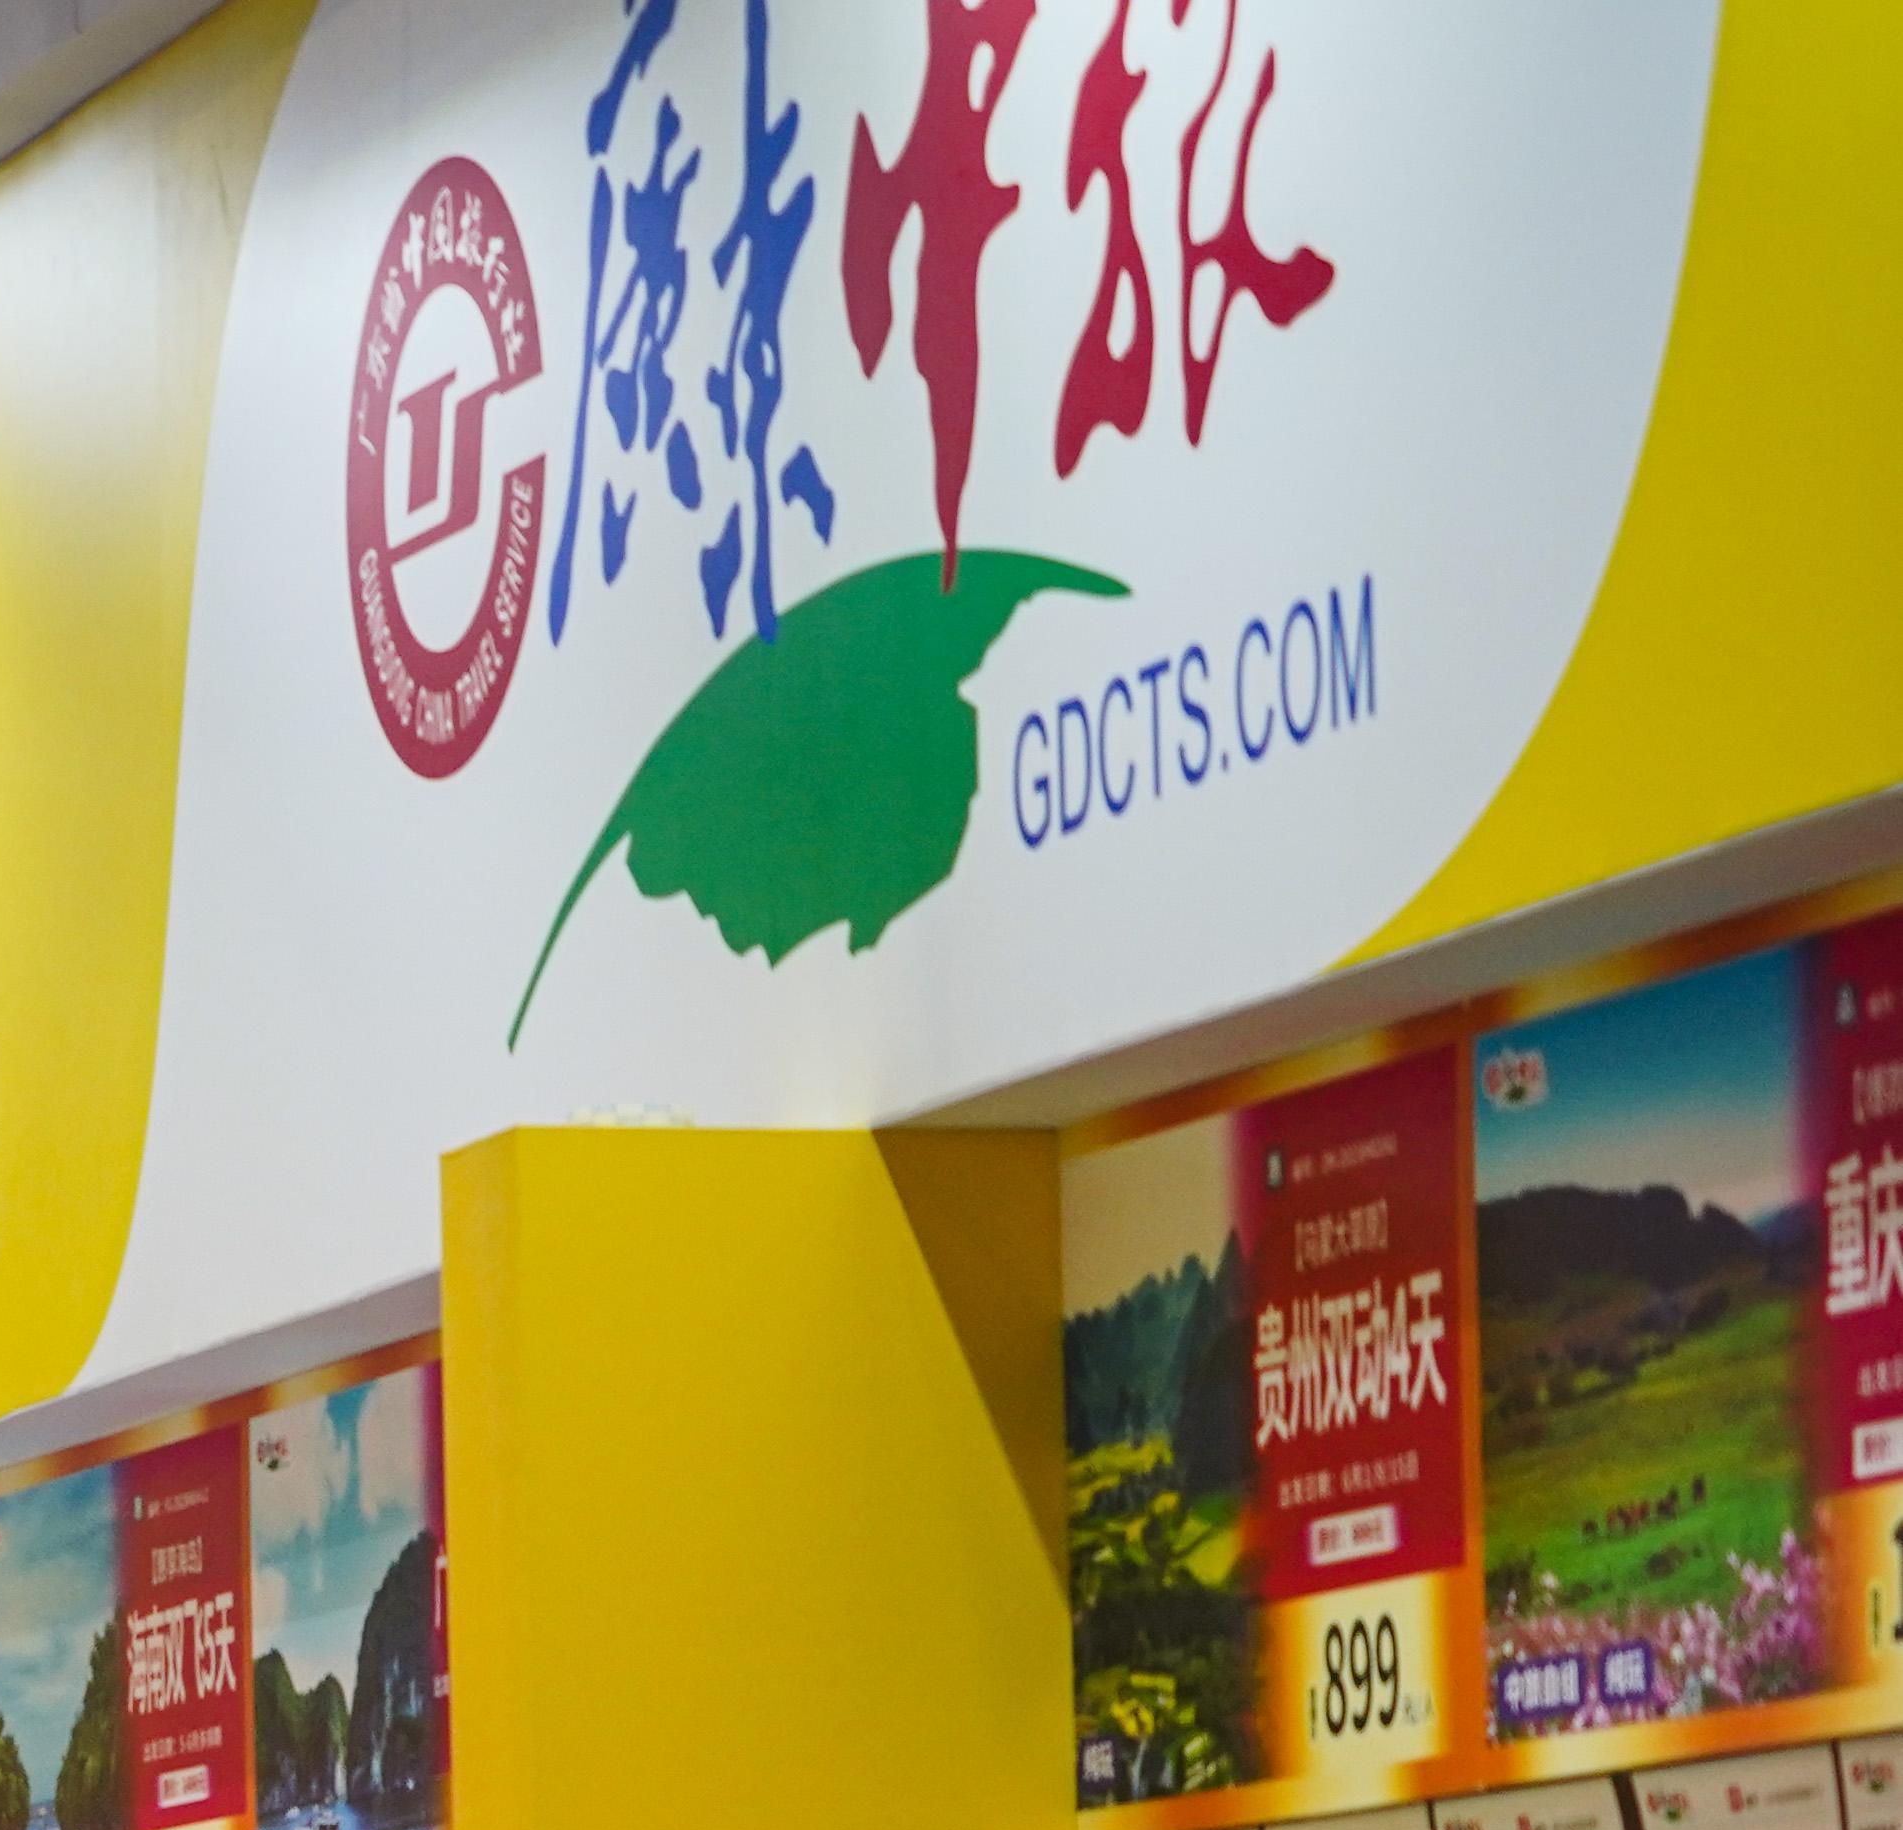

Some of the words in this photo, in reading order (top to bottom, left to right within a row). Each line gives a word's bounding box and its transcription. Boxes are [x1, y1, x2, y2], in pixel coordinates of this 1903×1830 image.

[357, 548, 414, 727] GUANGDONG
[415, 690, 456, 746] CHINA
[455, 630, 505, 730] TRAVEL
[494, 475, 534, 638] SERVICE
[1012, 574, 1376, 849] GDCTS.COM
[1254, 1269, 1447, 1450] 贵州双动4天
[126, 1591, 237, 1716] 海南双飞5天
[1324, 1610, 1401, 1738] 899
